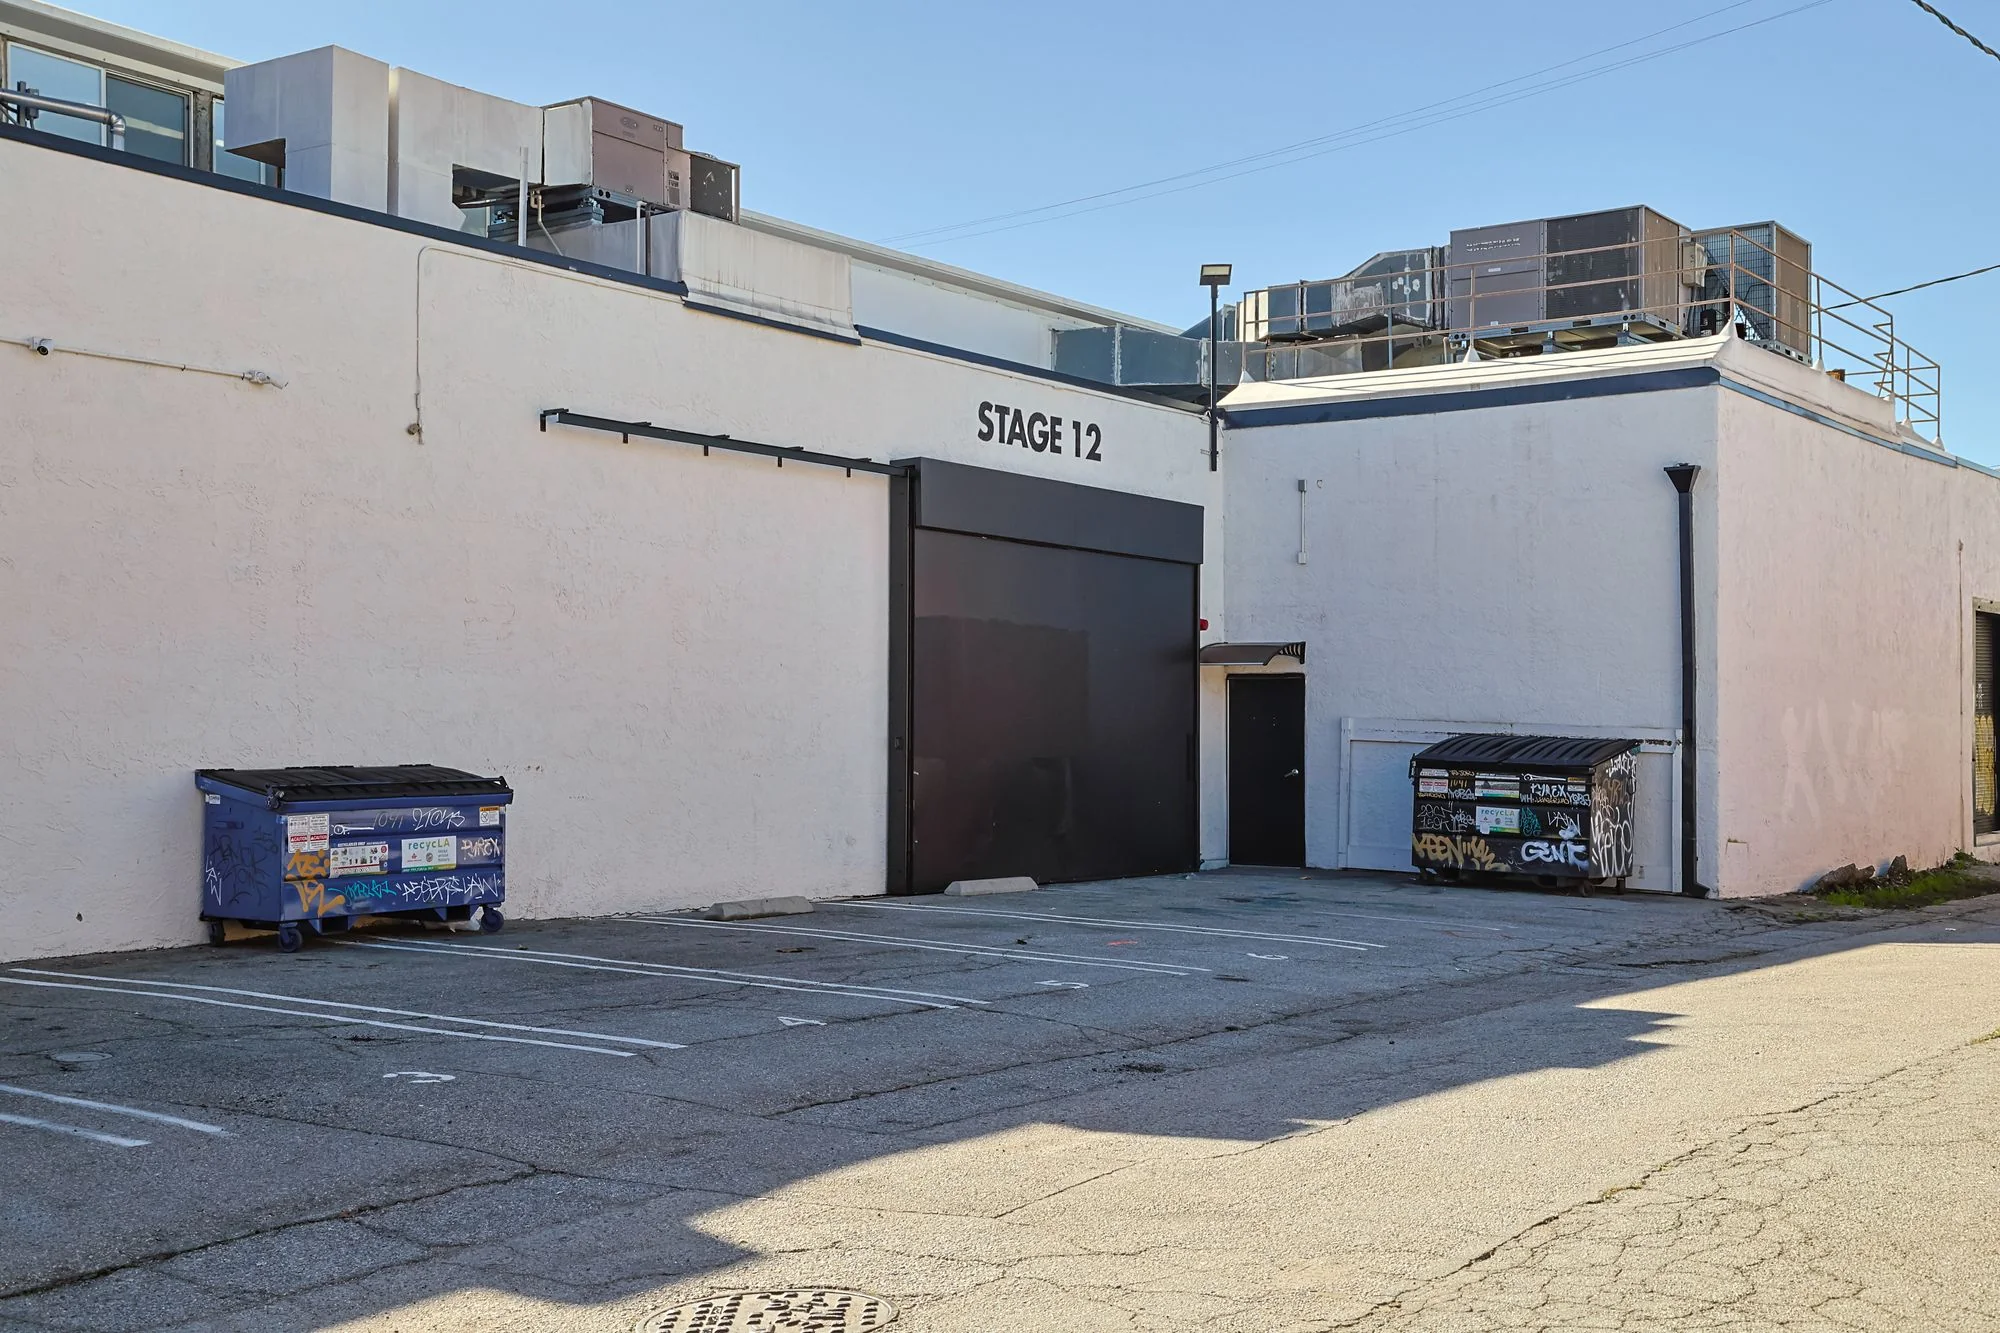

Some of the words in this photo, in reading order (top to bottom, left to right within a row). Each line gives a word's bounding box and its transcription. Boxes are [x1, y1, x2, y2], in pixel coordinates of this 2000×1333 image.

[977, 400, 1063, 455] STAGE
[1072, 420, 1102, 462] 12
[408, 838, 450, 852] recycLA
[1033, 979, 1090, 990] 5
[776, 1016, 828, 1026] 4
[382, 1071, 457, 1084] 3
